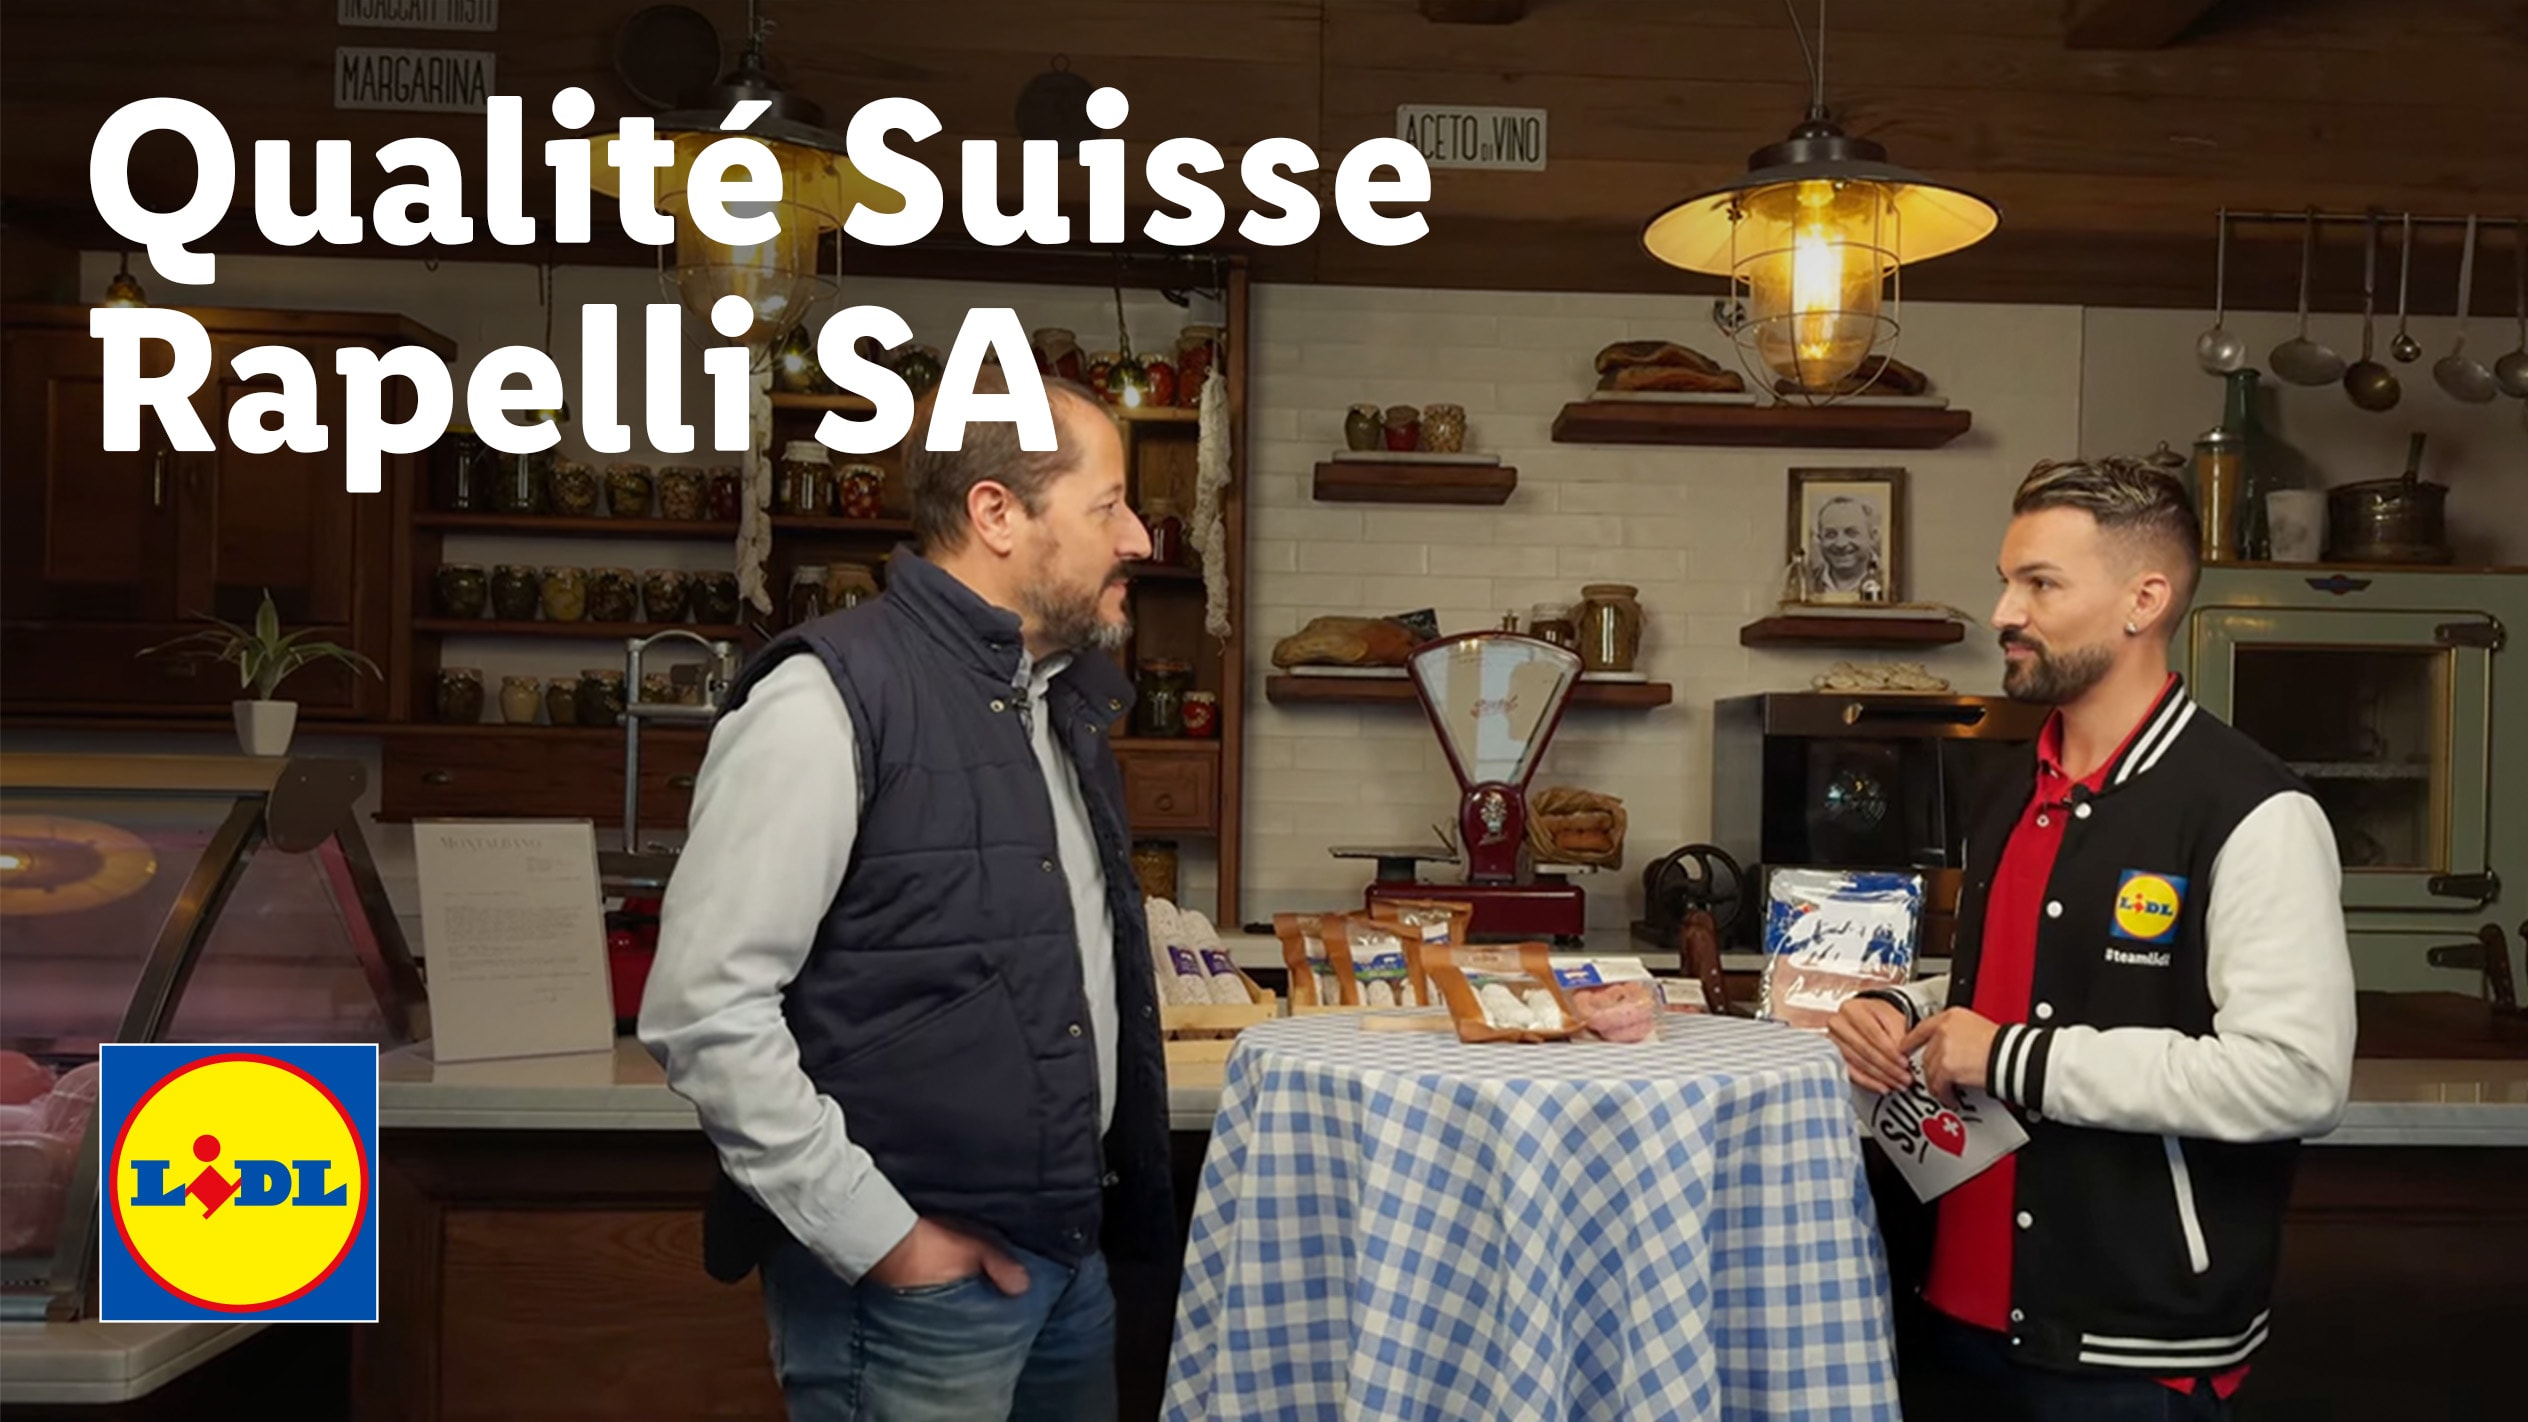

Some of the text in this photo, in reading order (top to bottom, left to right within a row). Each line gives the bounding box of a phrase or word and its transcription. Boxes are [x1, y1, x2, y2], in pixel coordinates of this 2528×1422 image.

[342, 55, 487, 105] MARGARINA
[1406, 113, 1478, 161] ACETO
[1492, 116, 1540, 163] VINO
